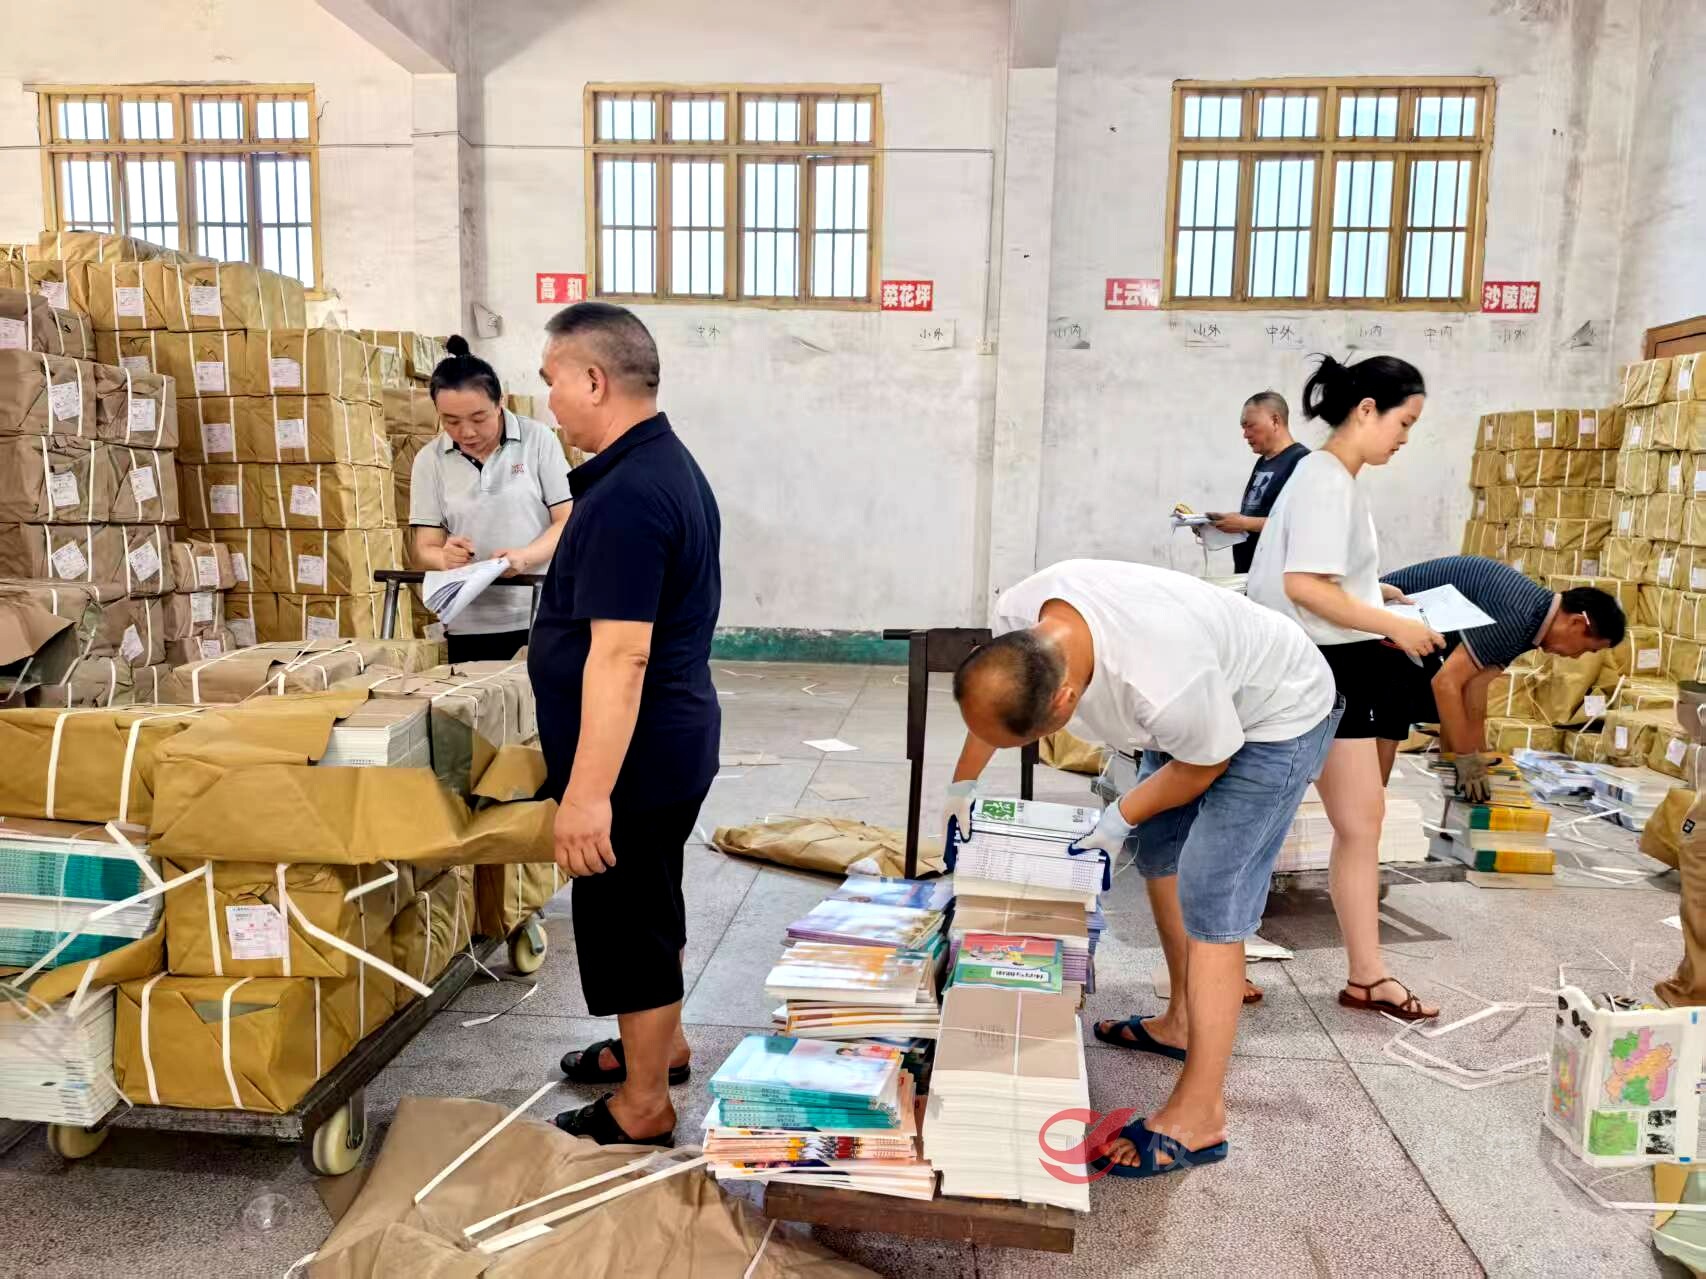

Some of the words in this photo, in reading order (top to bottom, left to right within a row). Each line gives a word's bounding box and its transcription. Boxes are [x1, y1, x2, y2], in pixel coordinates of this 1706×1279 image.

[883, 283, 931, 308] 菜花坪
[1264, 323, 1296, 345] 中外
